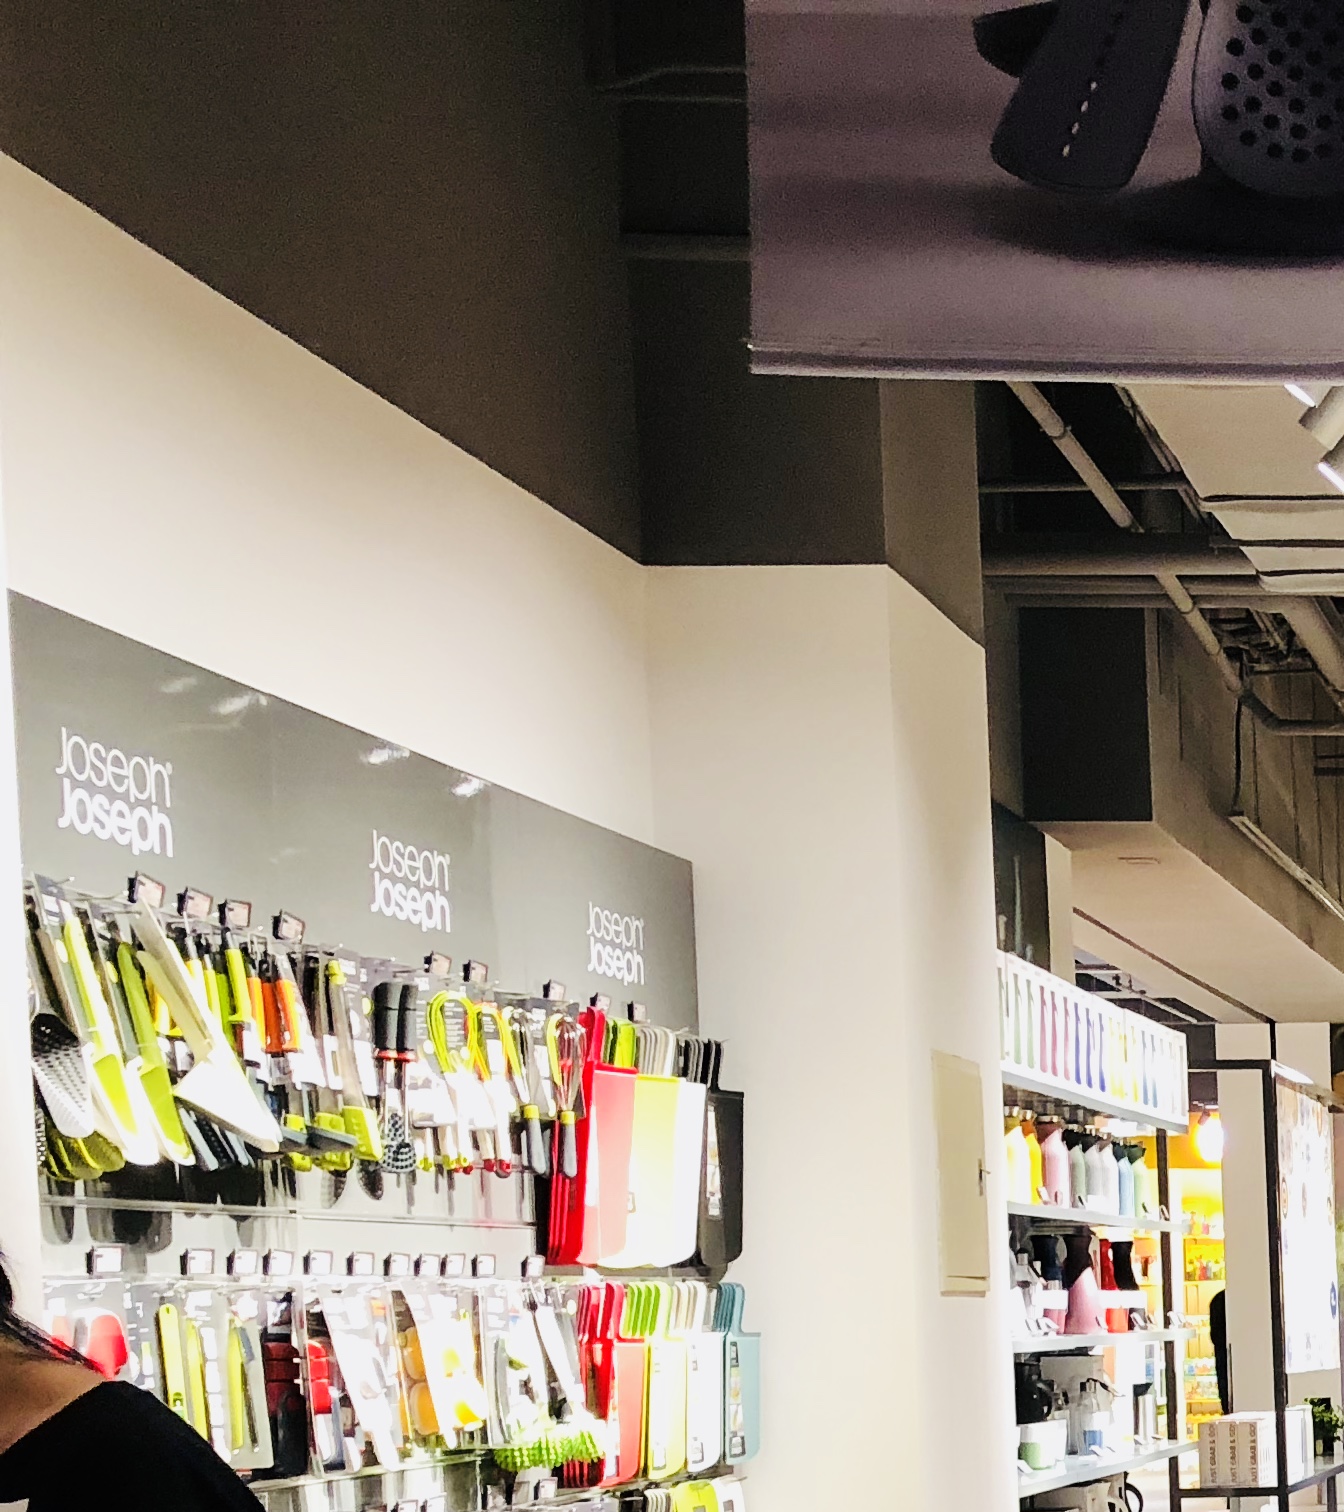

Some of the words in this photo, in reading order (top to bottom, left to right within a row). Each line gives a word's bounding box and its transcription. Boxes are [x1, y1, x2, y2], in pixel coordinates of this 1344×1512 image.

[57, 777, 174, 858] Joseph
[370, 871, 451, 933] Joseph
[587, 936, 645, 986] Joseph
